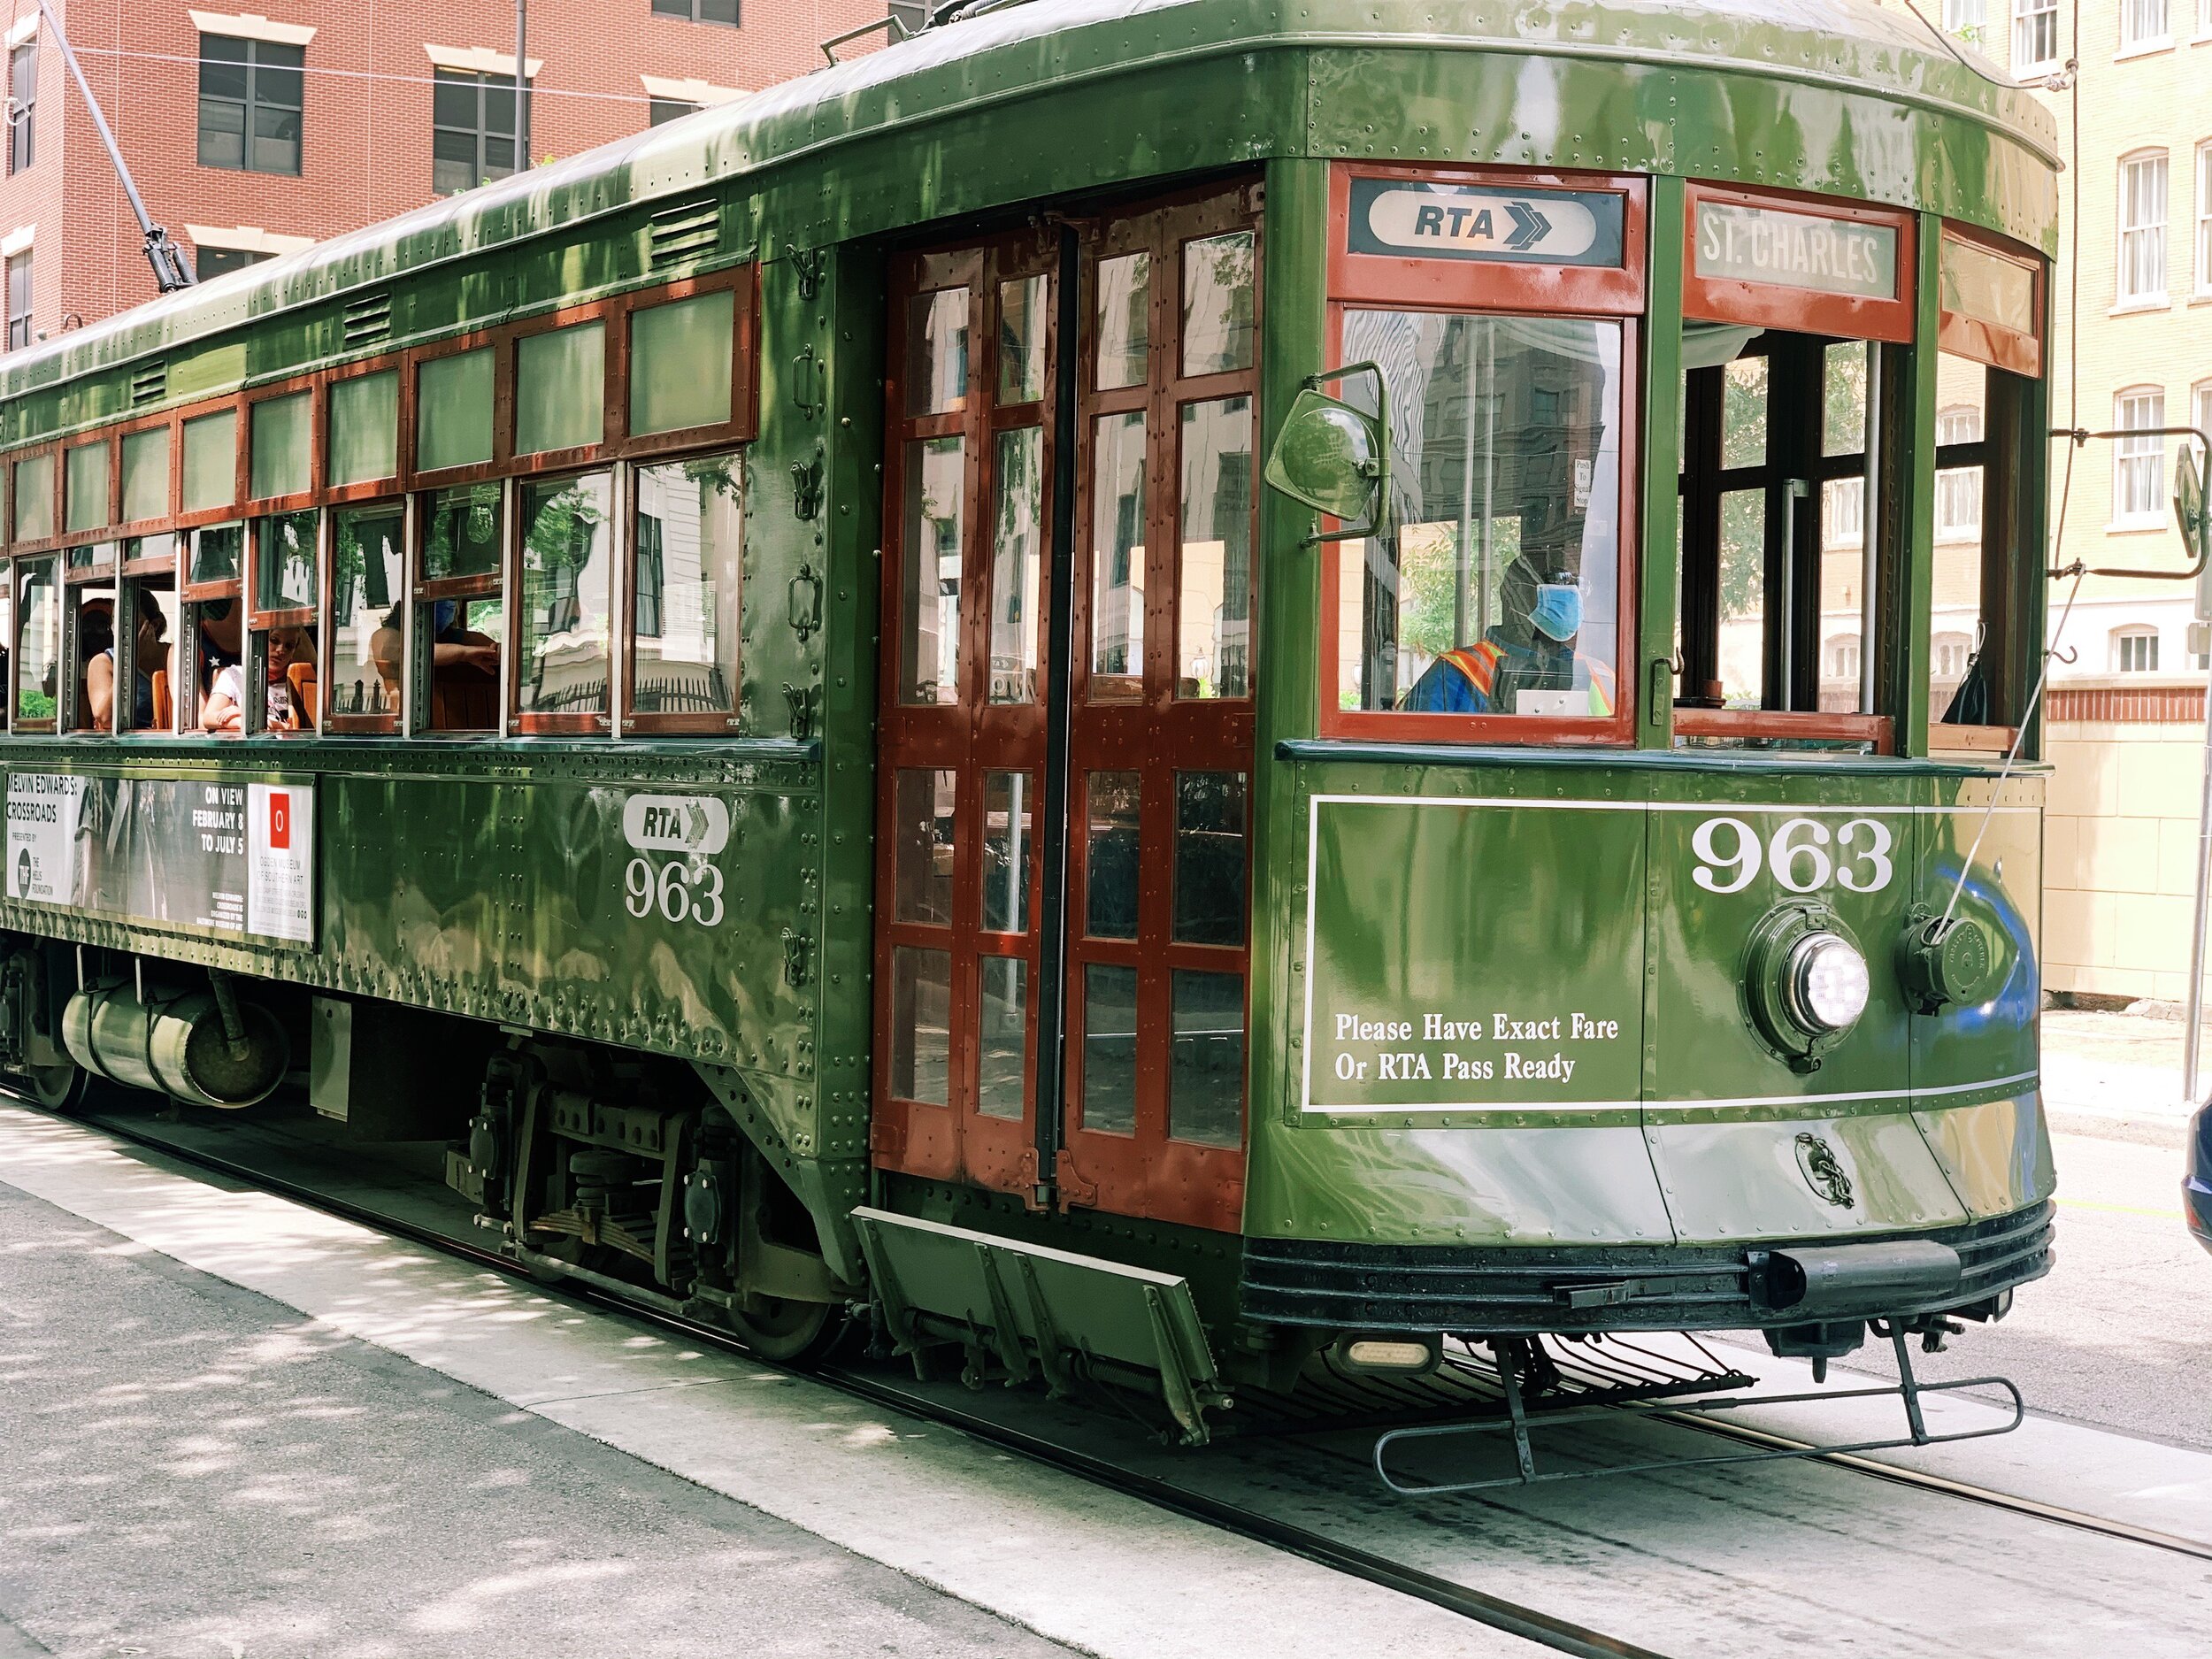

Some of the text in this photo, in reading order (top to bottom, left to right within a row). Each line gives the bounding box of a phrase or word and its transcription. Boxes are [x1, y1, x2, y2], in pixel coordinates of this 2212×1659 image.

[1415, 205, 1494, 239] RTA
[1703, 211, 1878, 284] ST. CHARLES
[1576, 461, 1590, 470] Push
[1579, 472, 1587, 481] To
[1576, 495, 1588, 506] Stop
[6, 773, 77, 795] MELVIN EDWARDS:
[205, 786, 243, 805] ON VIEW
[6, 801, 57, 823] CROSSROADS
[192, 809, 243, 830] FEBRUARY 8
[643, 806, 681, 839] RTA
[202, 833, 243, 855] TO JULY 5
[1692, 818, 1893, 894] 963
[626, 858, 724, 926] 963
[1334, 1012, 1618, 1041] Please Have Exact Fare
[1334, 1052, 1575, 1083] Or RTA Pass Ready
